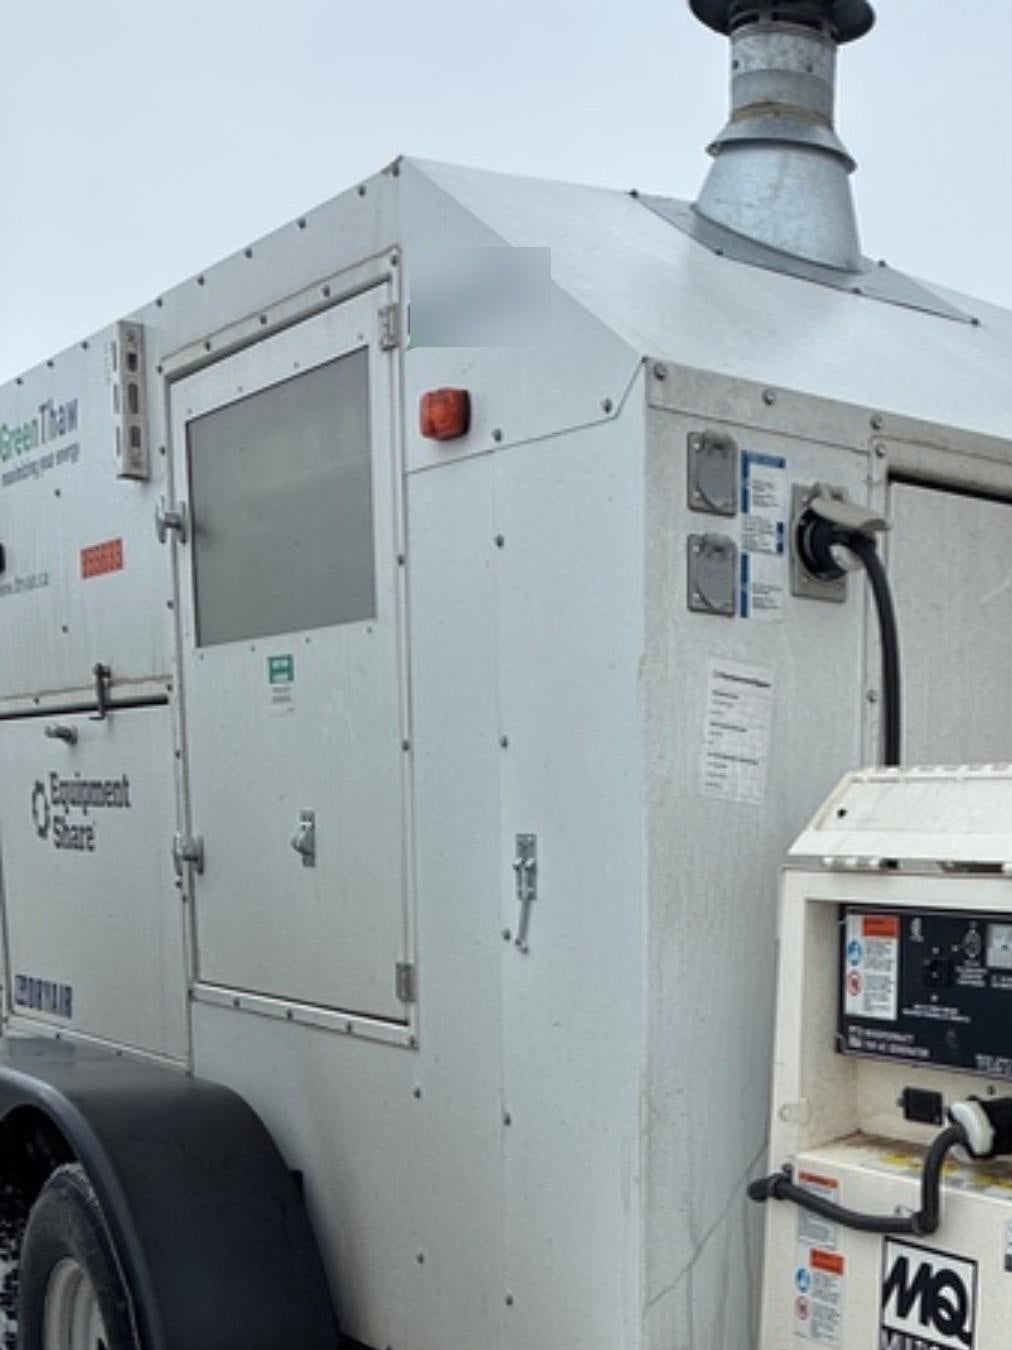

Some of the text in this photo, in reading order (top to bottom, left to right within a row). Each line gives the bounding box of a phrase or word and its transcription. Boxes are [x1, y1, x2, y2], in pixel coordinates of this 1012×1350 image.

[50, 771, 131, 816] Equipment
[53, 815, 95, 852] Share
[883, 1256, 972, 1343] MQ
